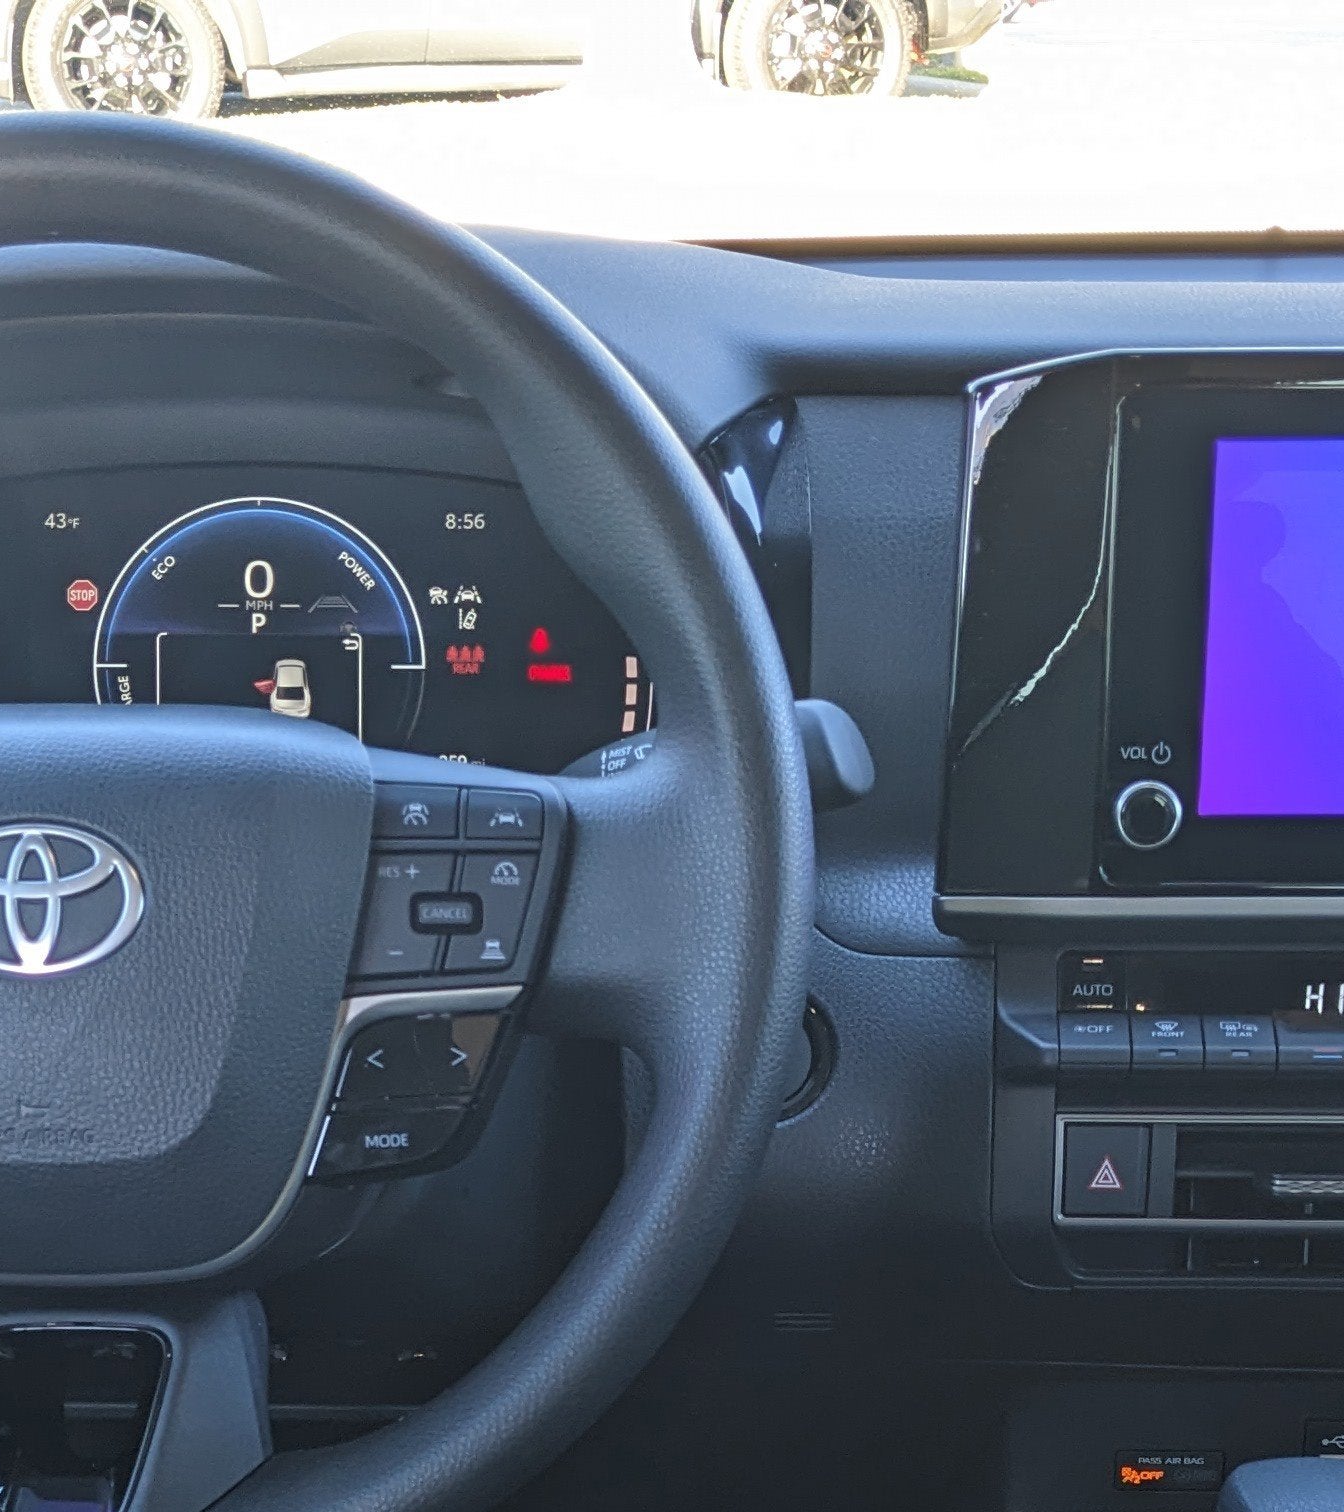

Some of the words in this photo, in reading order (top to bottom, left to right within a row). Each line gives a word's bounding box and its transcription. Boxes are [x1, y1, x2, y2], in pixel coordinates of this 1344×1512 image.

[445, 513, 486, 529] 8:56
[151, 555, 176, 581] ECO
[338, 551, 376, 591] POWER
[70, 590, 95, 601] STOP
[245, 600, 274, 611] MPH
[251, 613, 267, 634] P
[1120, 746, 1148, 760] VOL
[607, 758, 627, 771] OFF
[1072, 984, 1114, 996] AUTO
[1086, 1025, 1113, 1034] OFF
[364, 1133, 409, 1149] MODE
[1138, 1457, 1163, 1465] PASS
[1165, 1457, 1182, 1465] AIR
[1183, 1457, 1205, 1465] BAG
[1140, 1471, 1164, 1480] OFF
